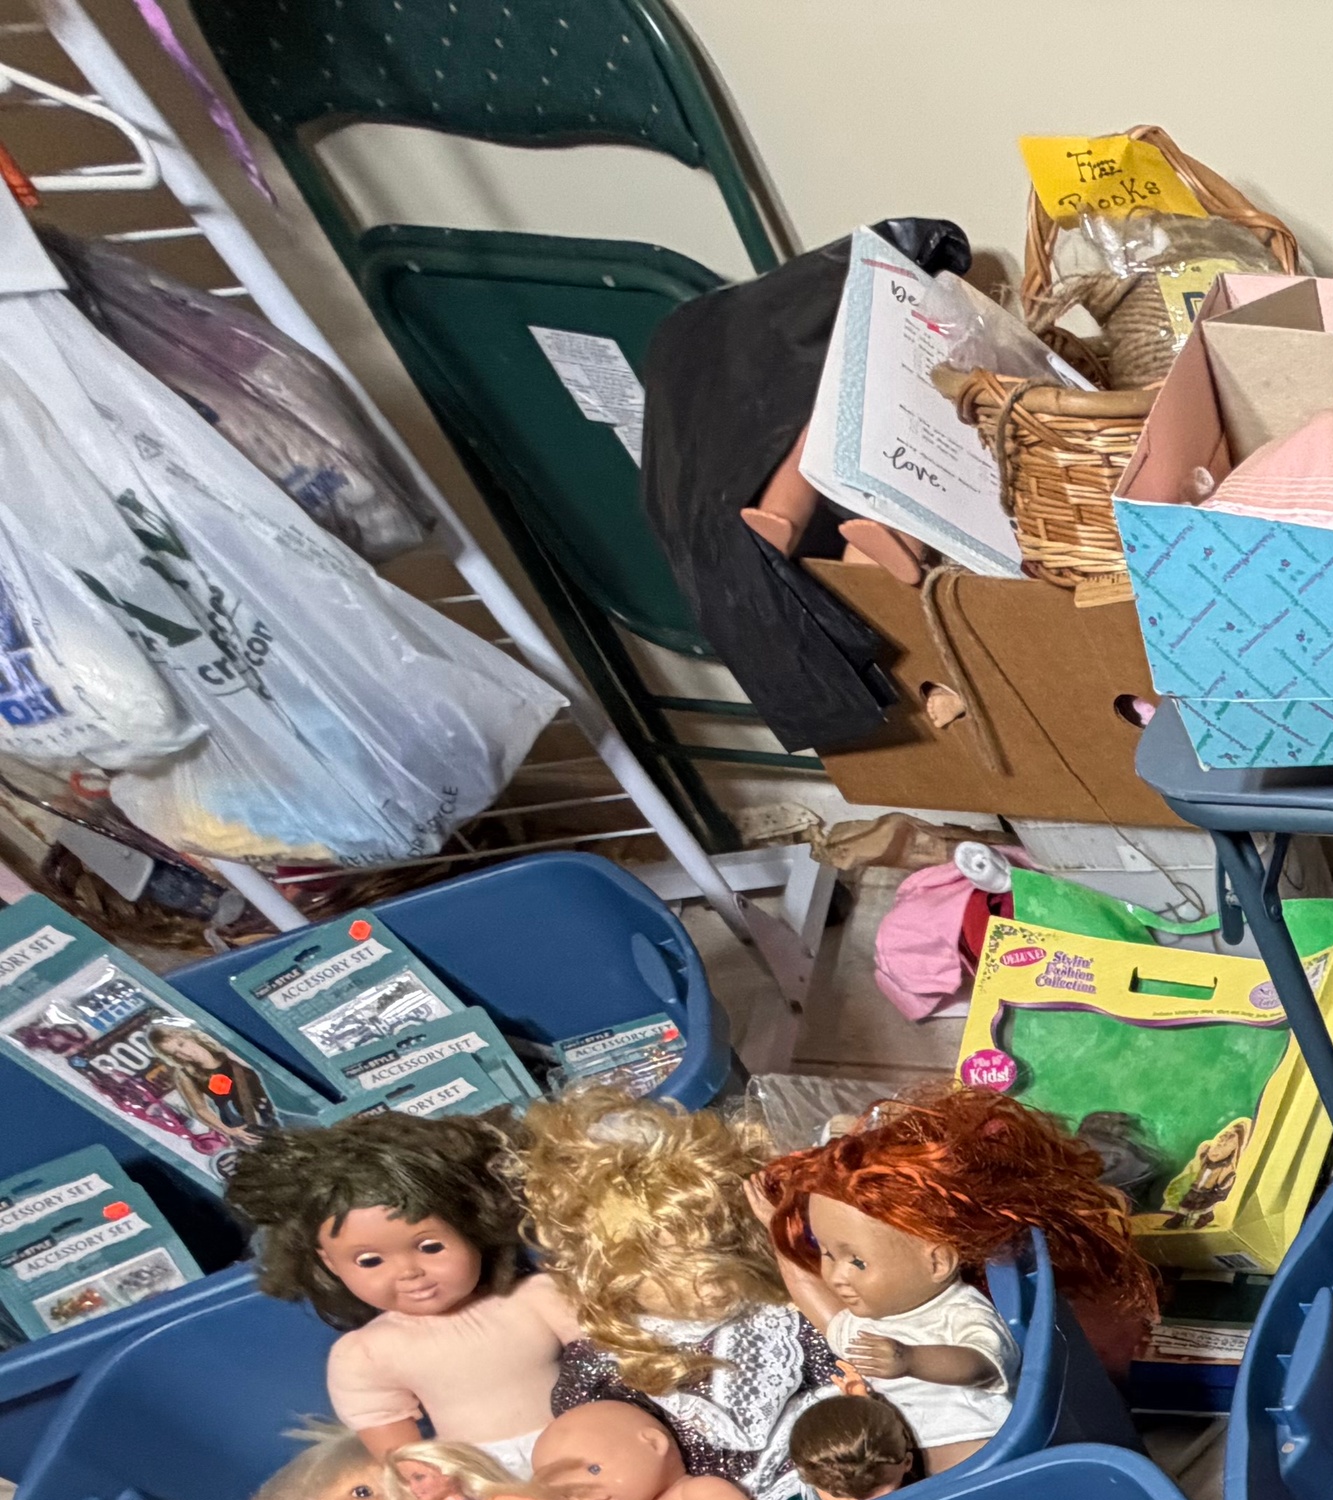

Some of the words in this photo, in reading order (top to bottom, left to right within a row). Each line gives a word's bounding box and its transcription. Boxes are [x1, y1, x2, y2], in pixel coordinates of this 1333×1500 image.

[29, 934, 57, 954] SET
[1002, 949, 1045, 966] DELUXE!
[280, 957, 351, 1003] ACCESSORY
[350, 945, 374, 964] SET
[1044, 961, 1095, 982] Fashion
[1035, 972, 1097, 994] Collection
[575, 1031, 648, 1058] ACCESSORY
[370, 1047, 445, 1085] ACCESSORY
[446, 1037, 473, 1053] SET
[968, 1067, 1010, 1086] Kids!
[436, 1084, 462, 1101] SET
[66, 1180, 95, 1198] SET
[26, 1231, 106, 1273] ACCESSORY
[107, 1219, 134, 1237] SET
